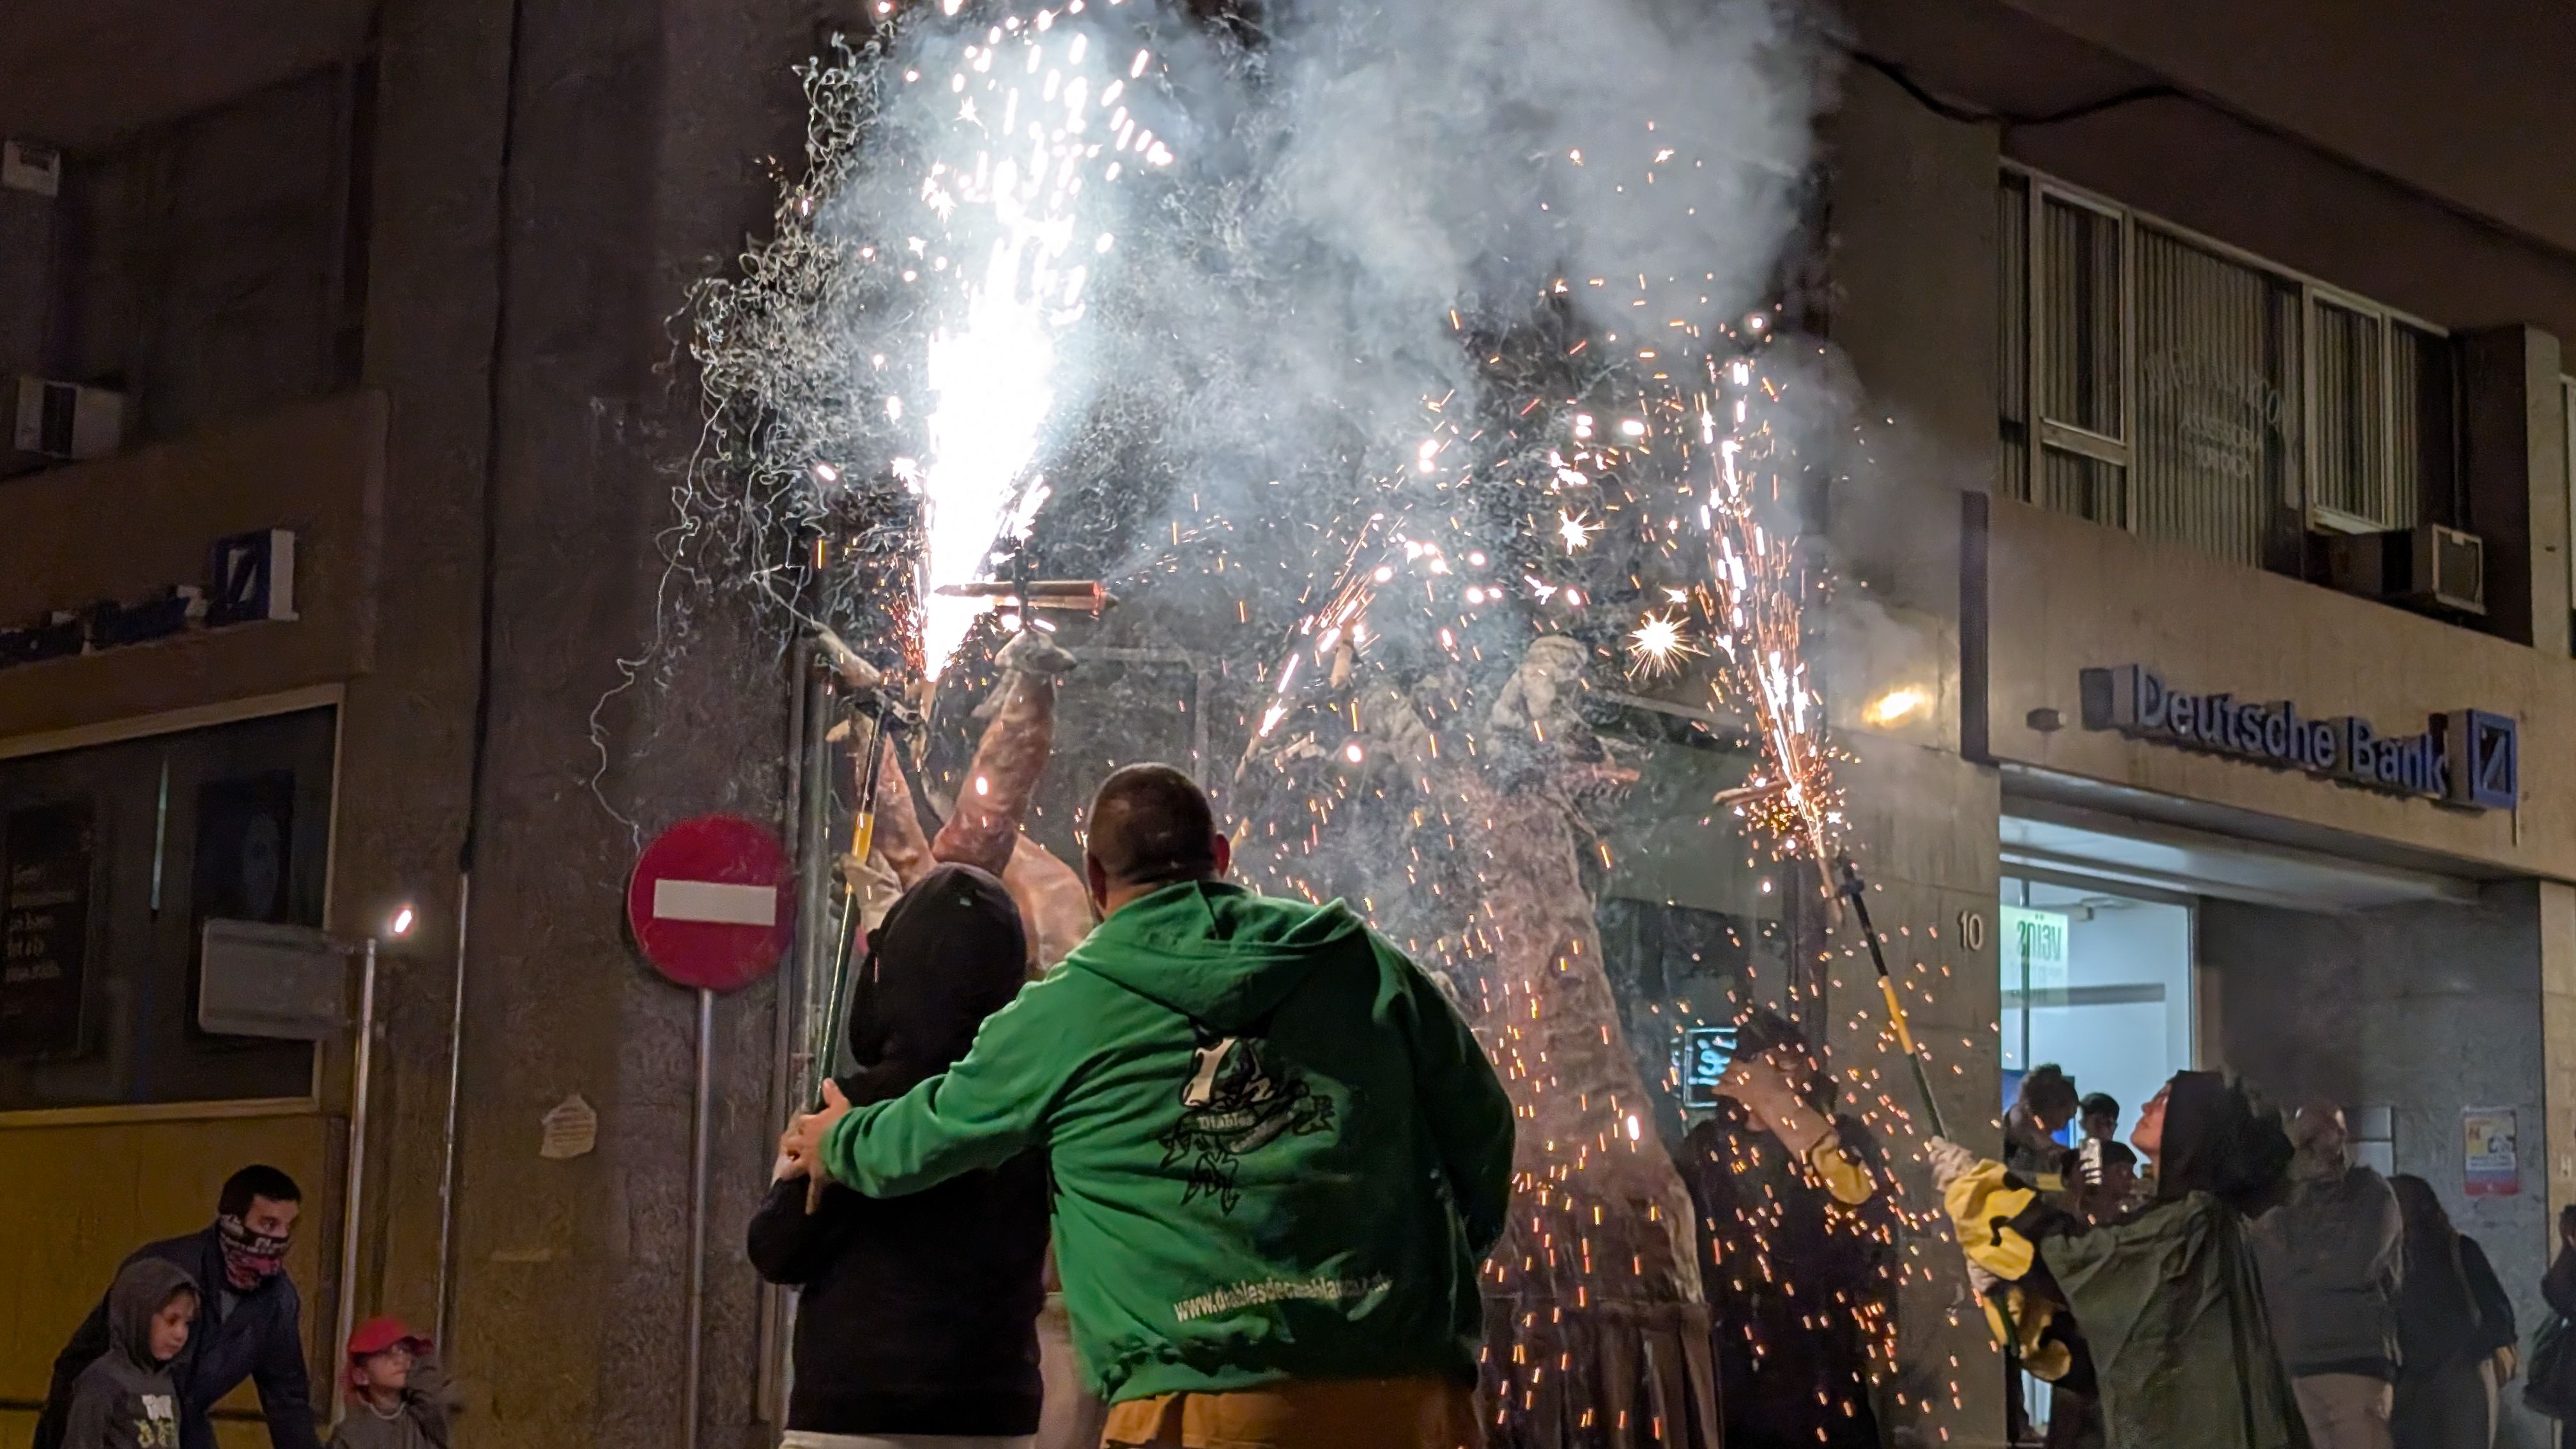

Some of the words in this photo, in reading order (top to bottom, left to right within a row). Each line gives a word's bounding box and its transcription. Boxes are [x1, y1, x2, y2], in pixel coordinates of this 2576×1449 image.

[2135, 664, 2336, 767] Deutsche
[2349, 717, 2450, 797] Bank
[1959, 910, 1984, 951] 10
